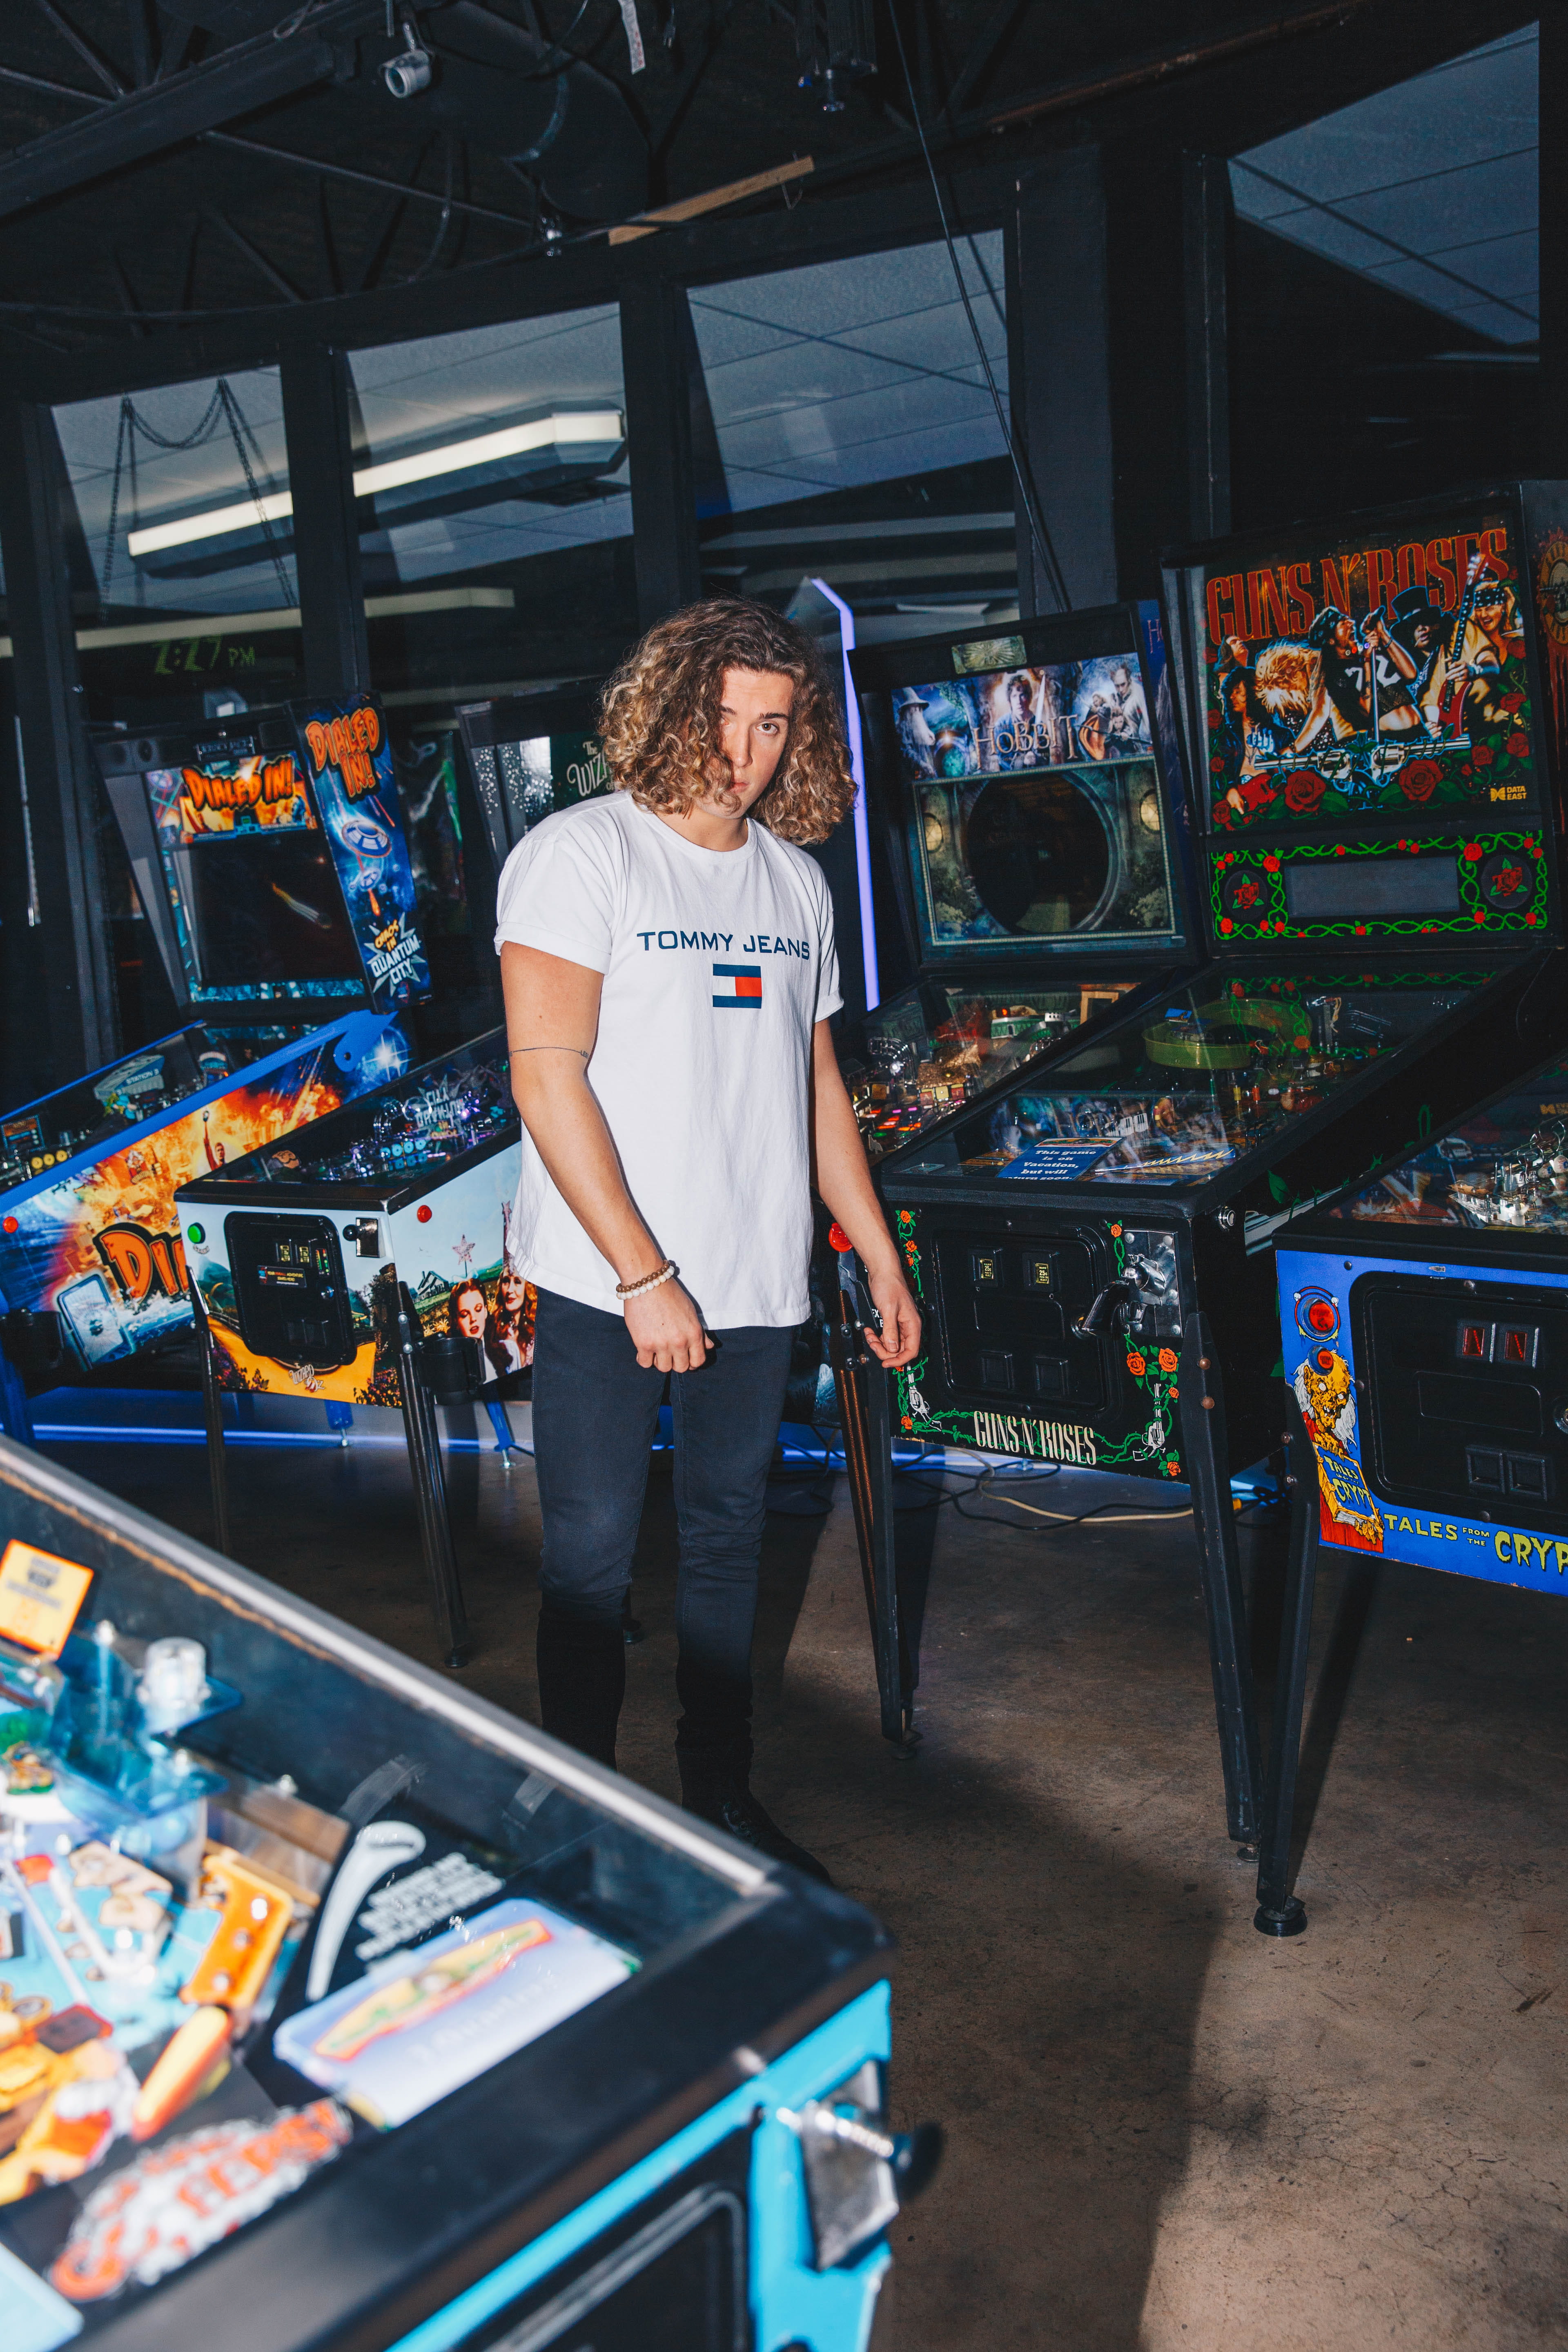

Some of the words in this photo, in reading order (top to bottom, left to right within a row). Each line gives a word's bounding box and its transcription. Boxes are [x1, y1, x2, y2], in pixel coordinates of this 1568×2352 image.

[1206, 562, 1315, 645] GUNS
[1362, 528, 1510, 621] ROSES
[228, 646, 256, 667] PM
[305, 707, 380, 772] DIALED
[582, 741, 598, 755] The
[972, 714, 1078, 772] HOBBIT
[181, 768, 262, 809] DIALED
[264, 757, 293, 802] IN!
[340, 752, 376, 798] IN!
[374, 919, 399, 949] CHAOS
[386, 936, 397, 952] IN
[637, 931, 733, 951] TOMMY
[743, 935, 810, 960] JEANS
[371, 934, 420, 978] QUANTUM
[389, 958, 412, 984] CITY
[973, 1411, 1020, 1453] GUNS
[1039, 1420, 1097, 1465] ROSES
[1323, 1455, 1359, 1479] TALES
[1332, 1478, 1373, 1507] CRYPT
[1383, 1513, 1458, 1541] TALES
[1463, 1527, 1490, 1537] FROM
[1467, 1538, 1486, 1547] THE
